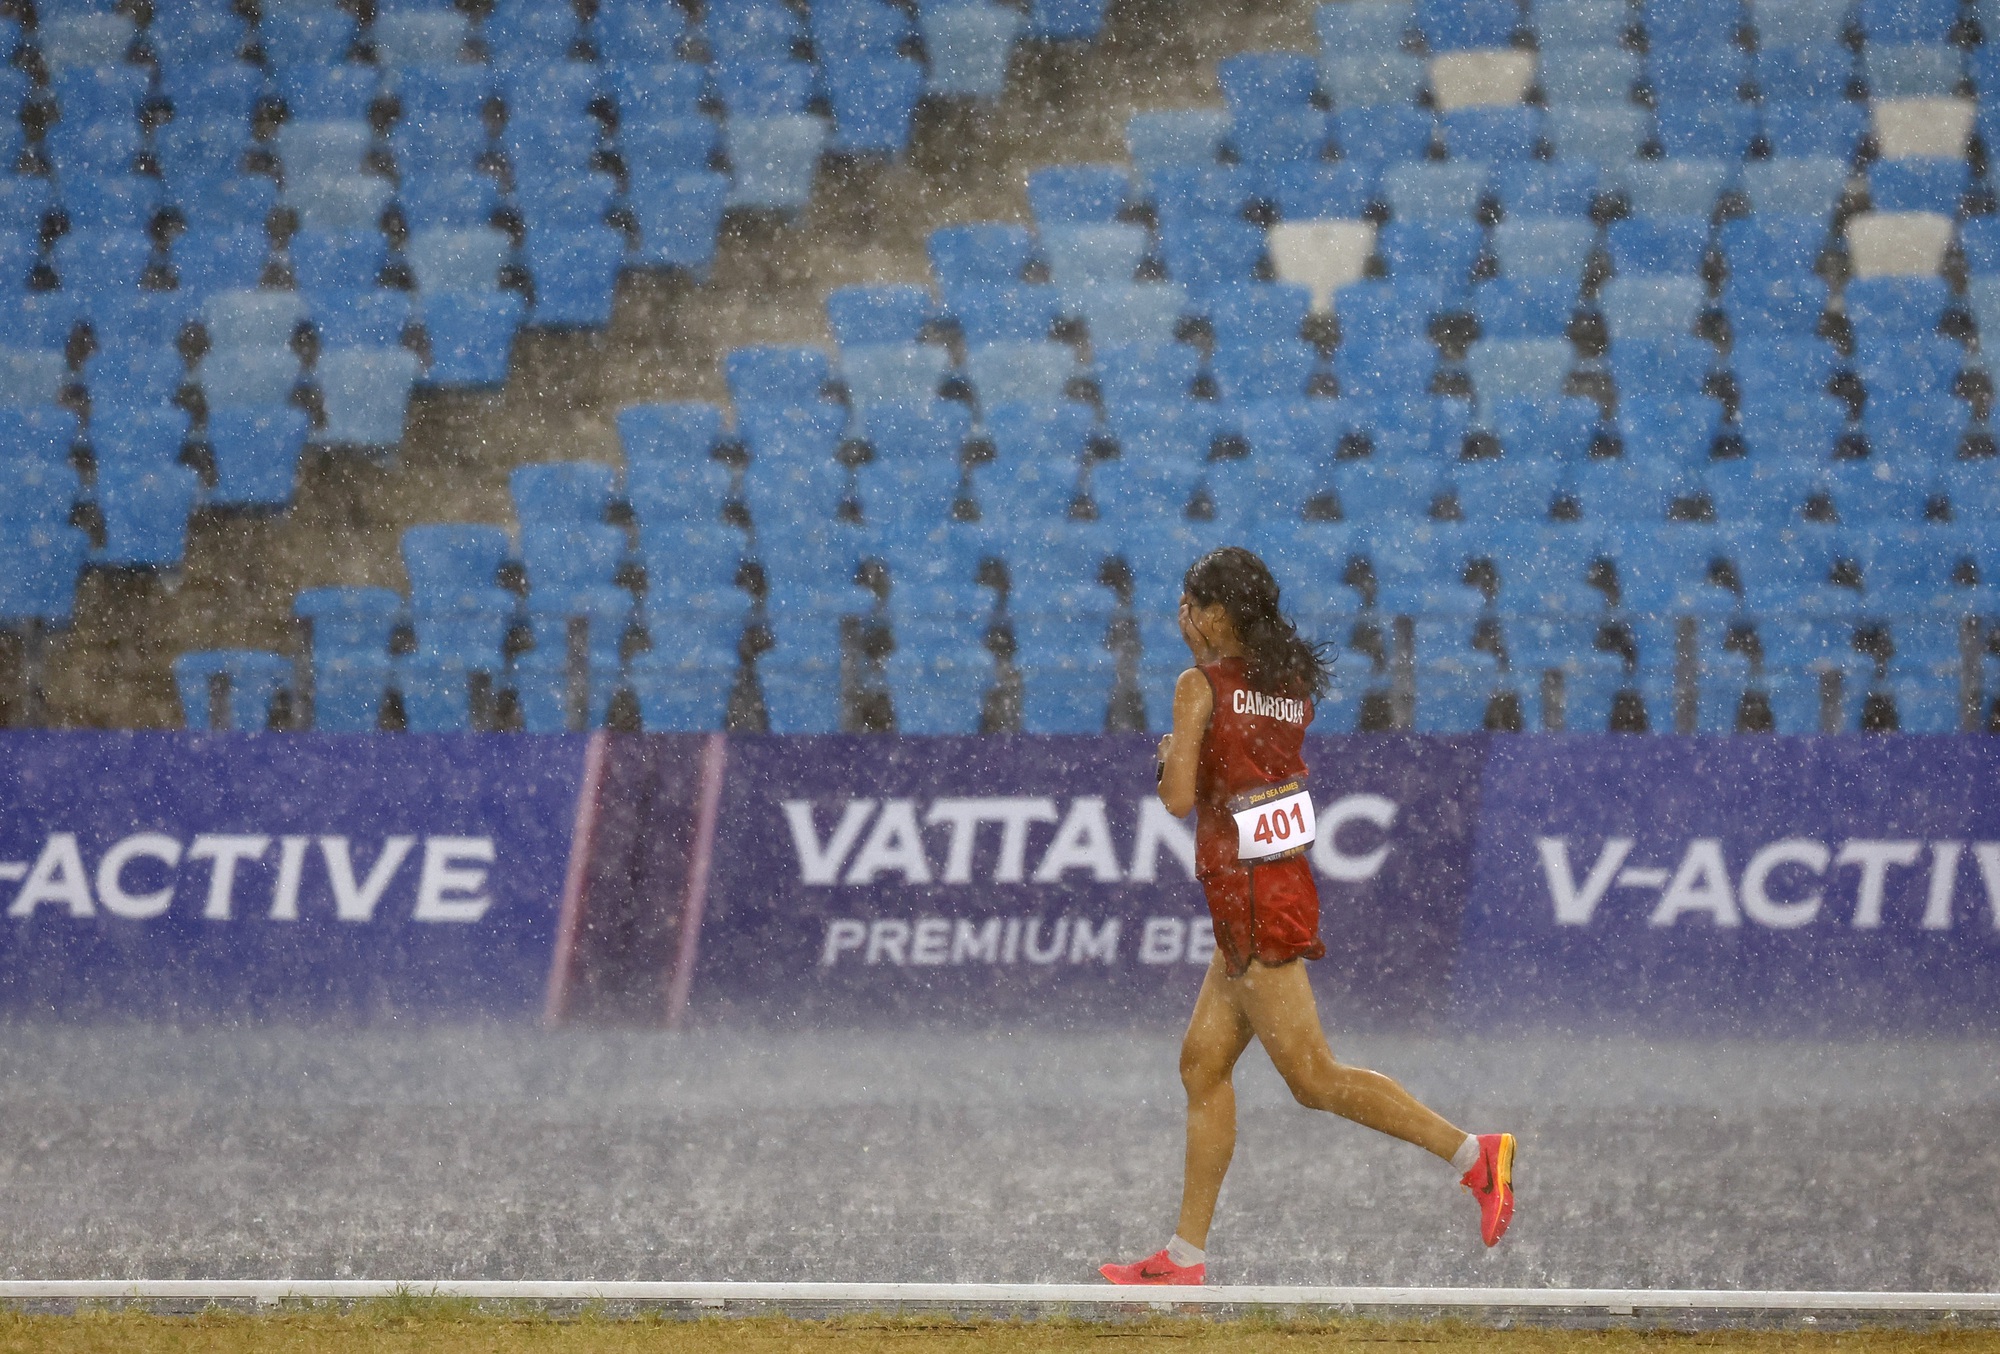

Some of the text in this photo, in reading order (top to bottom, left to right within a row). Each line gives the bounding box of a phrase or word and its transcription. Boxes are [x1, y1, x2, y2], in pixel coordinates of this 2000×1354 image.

[1266, 788, 1279, 798] SEA
[1279, 781, 1299, 794] GAMES
[784, 795, 1397, 885] VATTANC
[1254, 803, 1306, 845] 401
[820, 916, 1216, 966] PREMIUM BE
